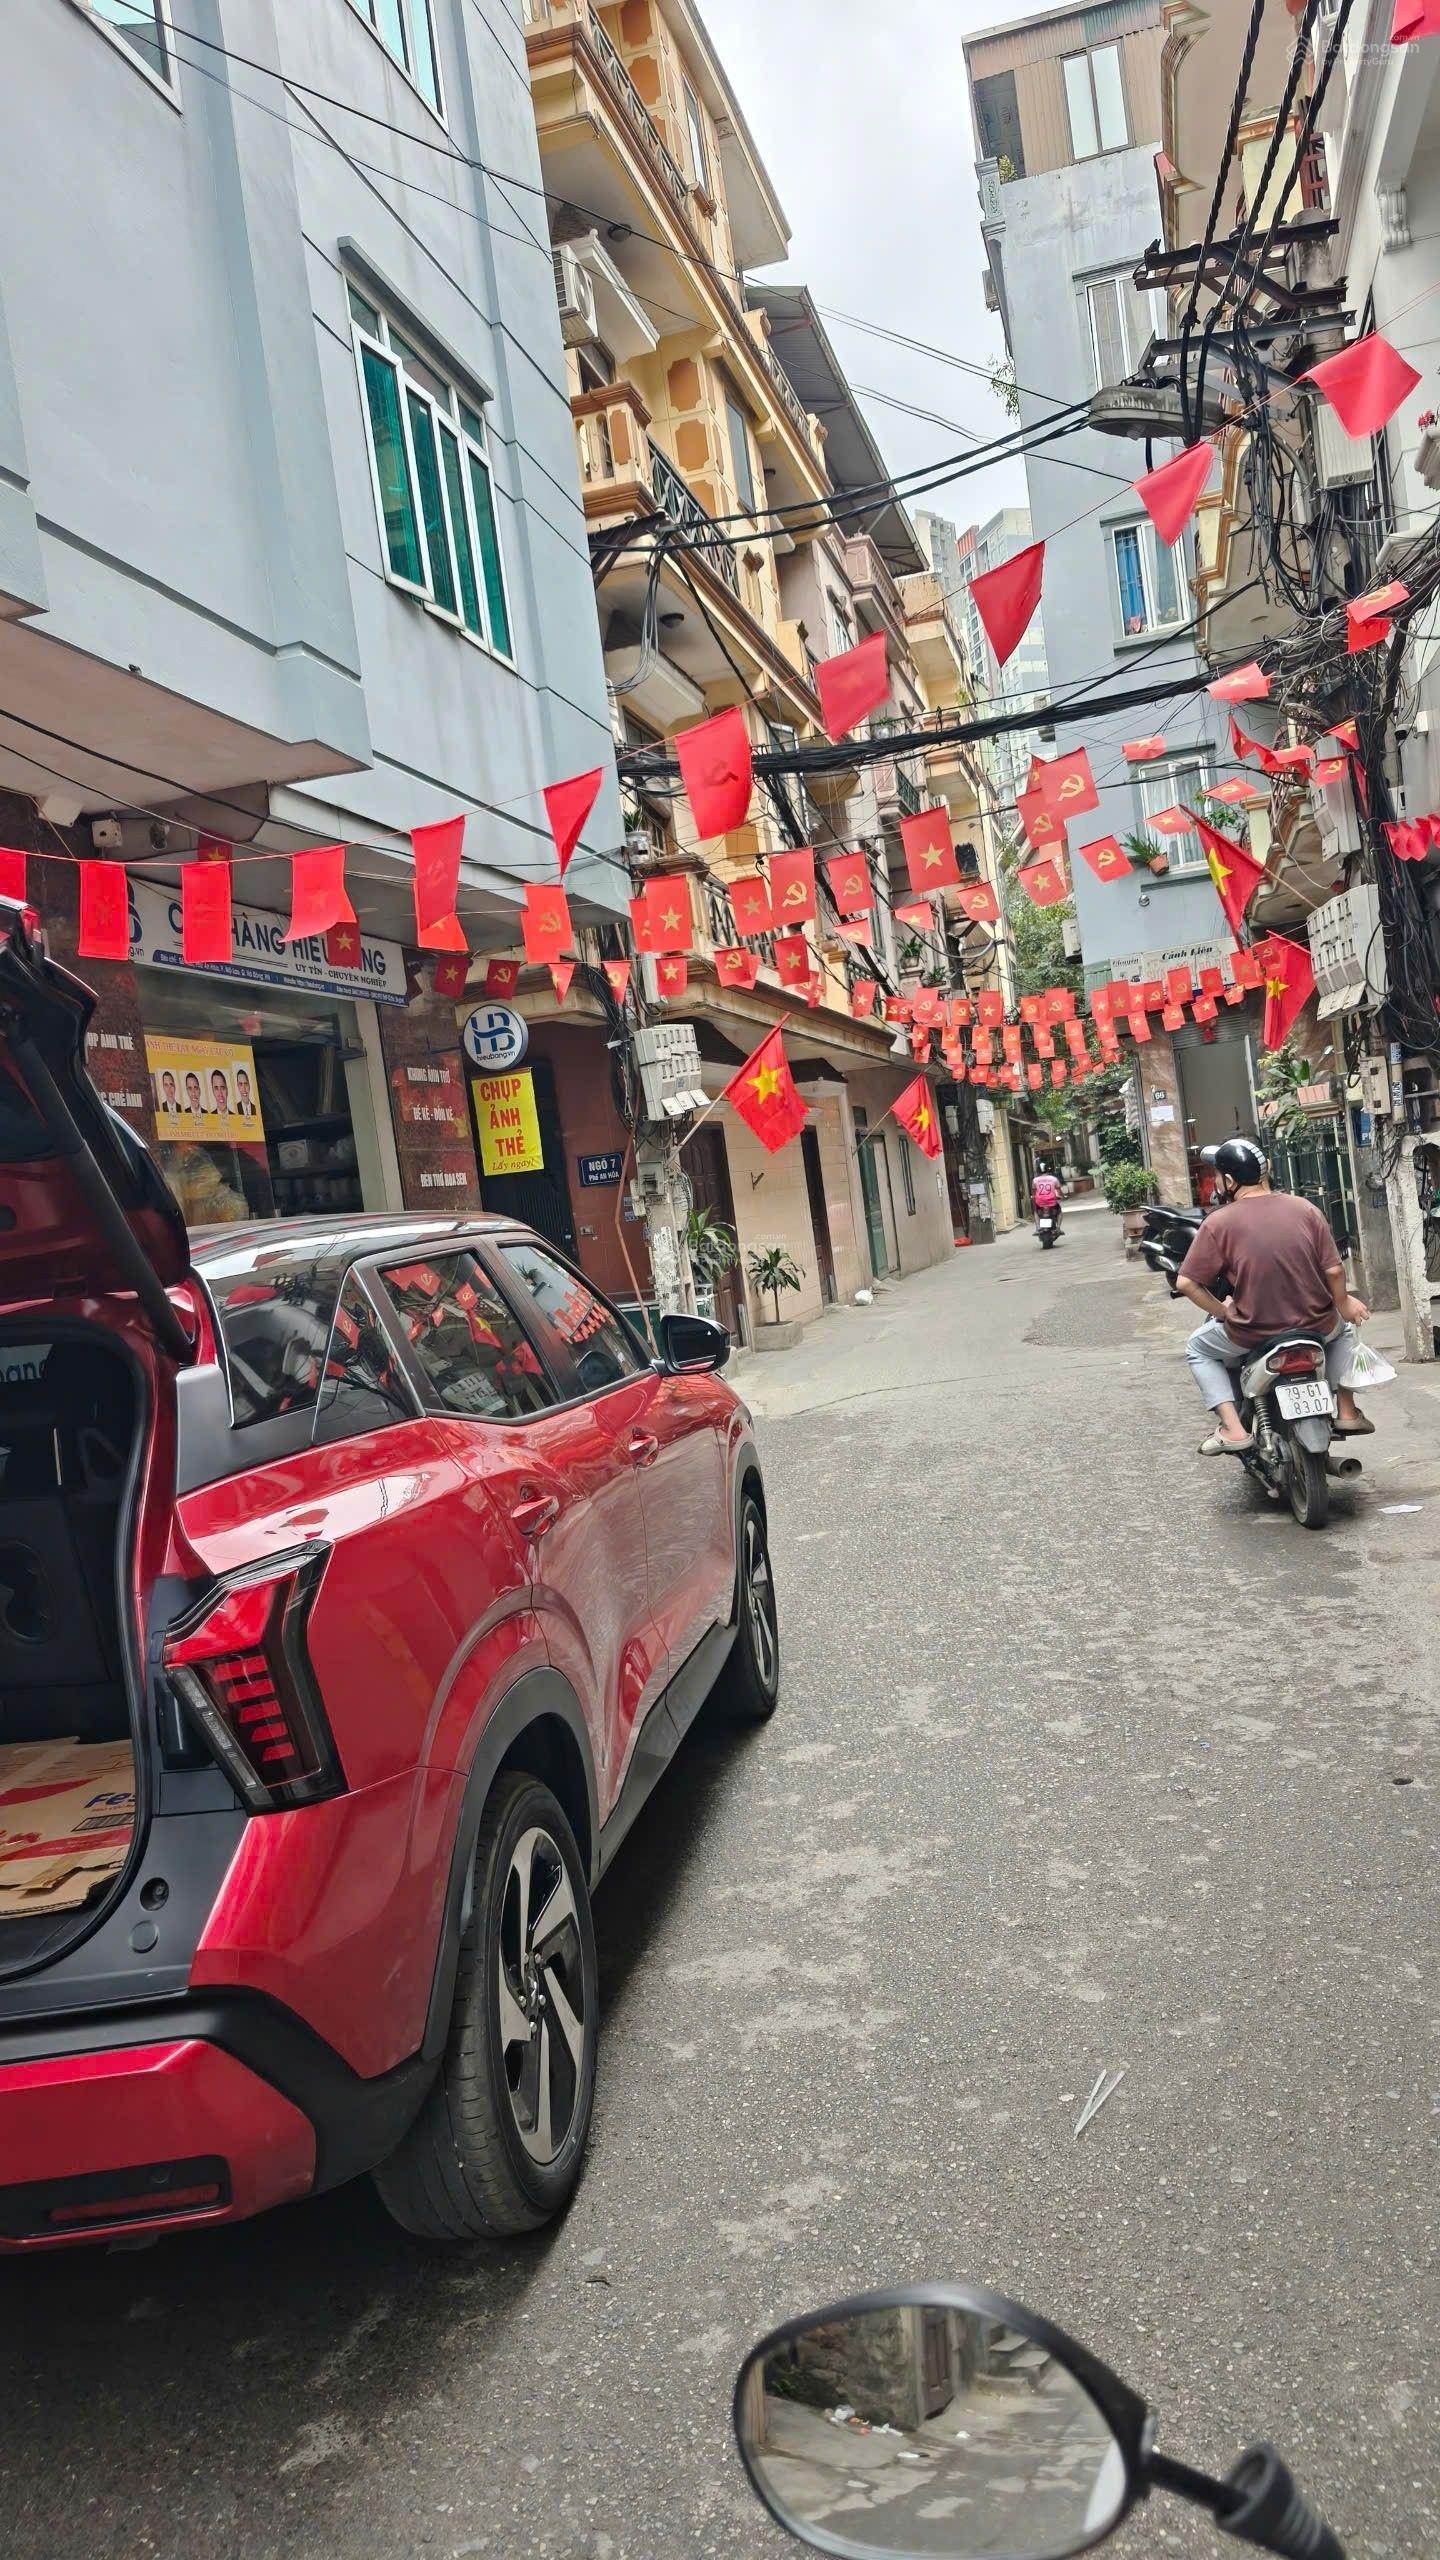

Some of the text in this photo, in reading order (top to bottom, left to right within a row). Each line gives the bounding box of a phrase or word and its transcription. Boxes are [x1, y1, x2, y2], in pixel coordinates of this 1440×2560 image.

[295, 963, 307, 973] UY
[308, 964, 323, 976] TÍN
[328, 969, 360, 983] CHUYÊN
[360, 976, 387, 989] NGHIỆP
[87, 1032, 99, 1049] ỤP
[470, 1012, 516, 1055] HB
[480, 1078, 521, 1103] CHỤP
[490, 1104, 521, 1129] ẢNH
[495, 1129, 526, 1157] THẺ
[492, 1157, 535, 1171] Lấy ngay!
[588, 1158, 616, 1172] NGÕ 7
[1038, 1183, 1052, 1196] 29
[1293, 1397, 1329, 1415] 83.07
